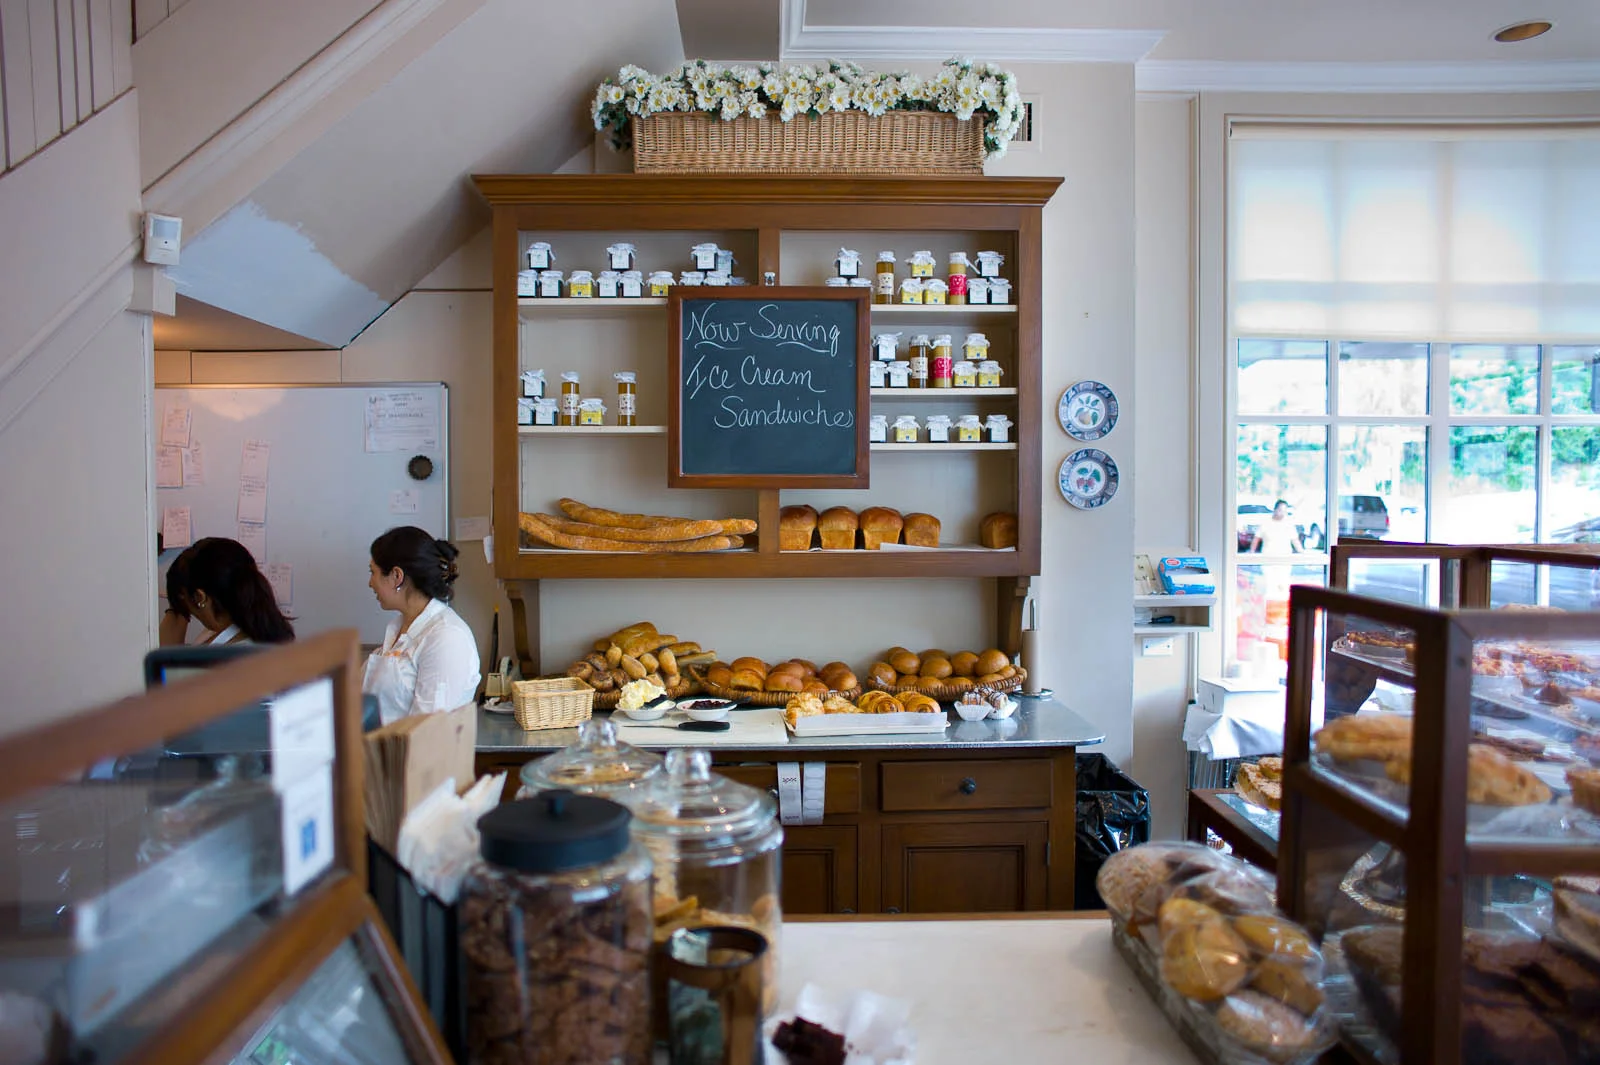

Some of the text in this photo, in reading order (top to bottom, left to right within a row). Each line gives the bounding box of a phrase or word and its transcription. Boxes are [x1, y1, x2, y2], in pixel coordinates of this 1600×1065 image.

[685, 302, 841, 358] Now Serving
[686, 354, 827, 400] Ice Cream
[713, 395, 855, 429] Sandwiches
